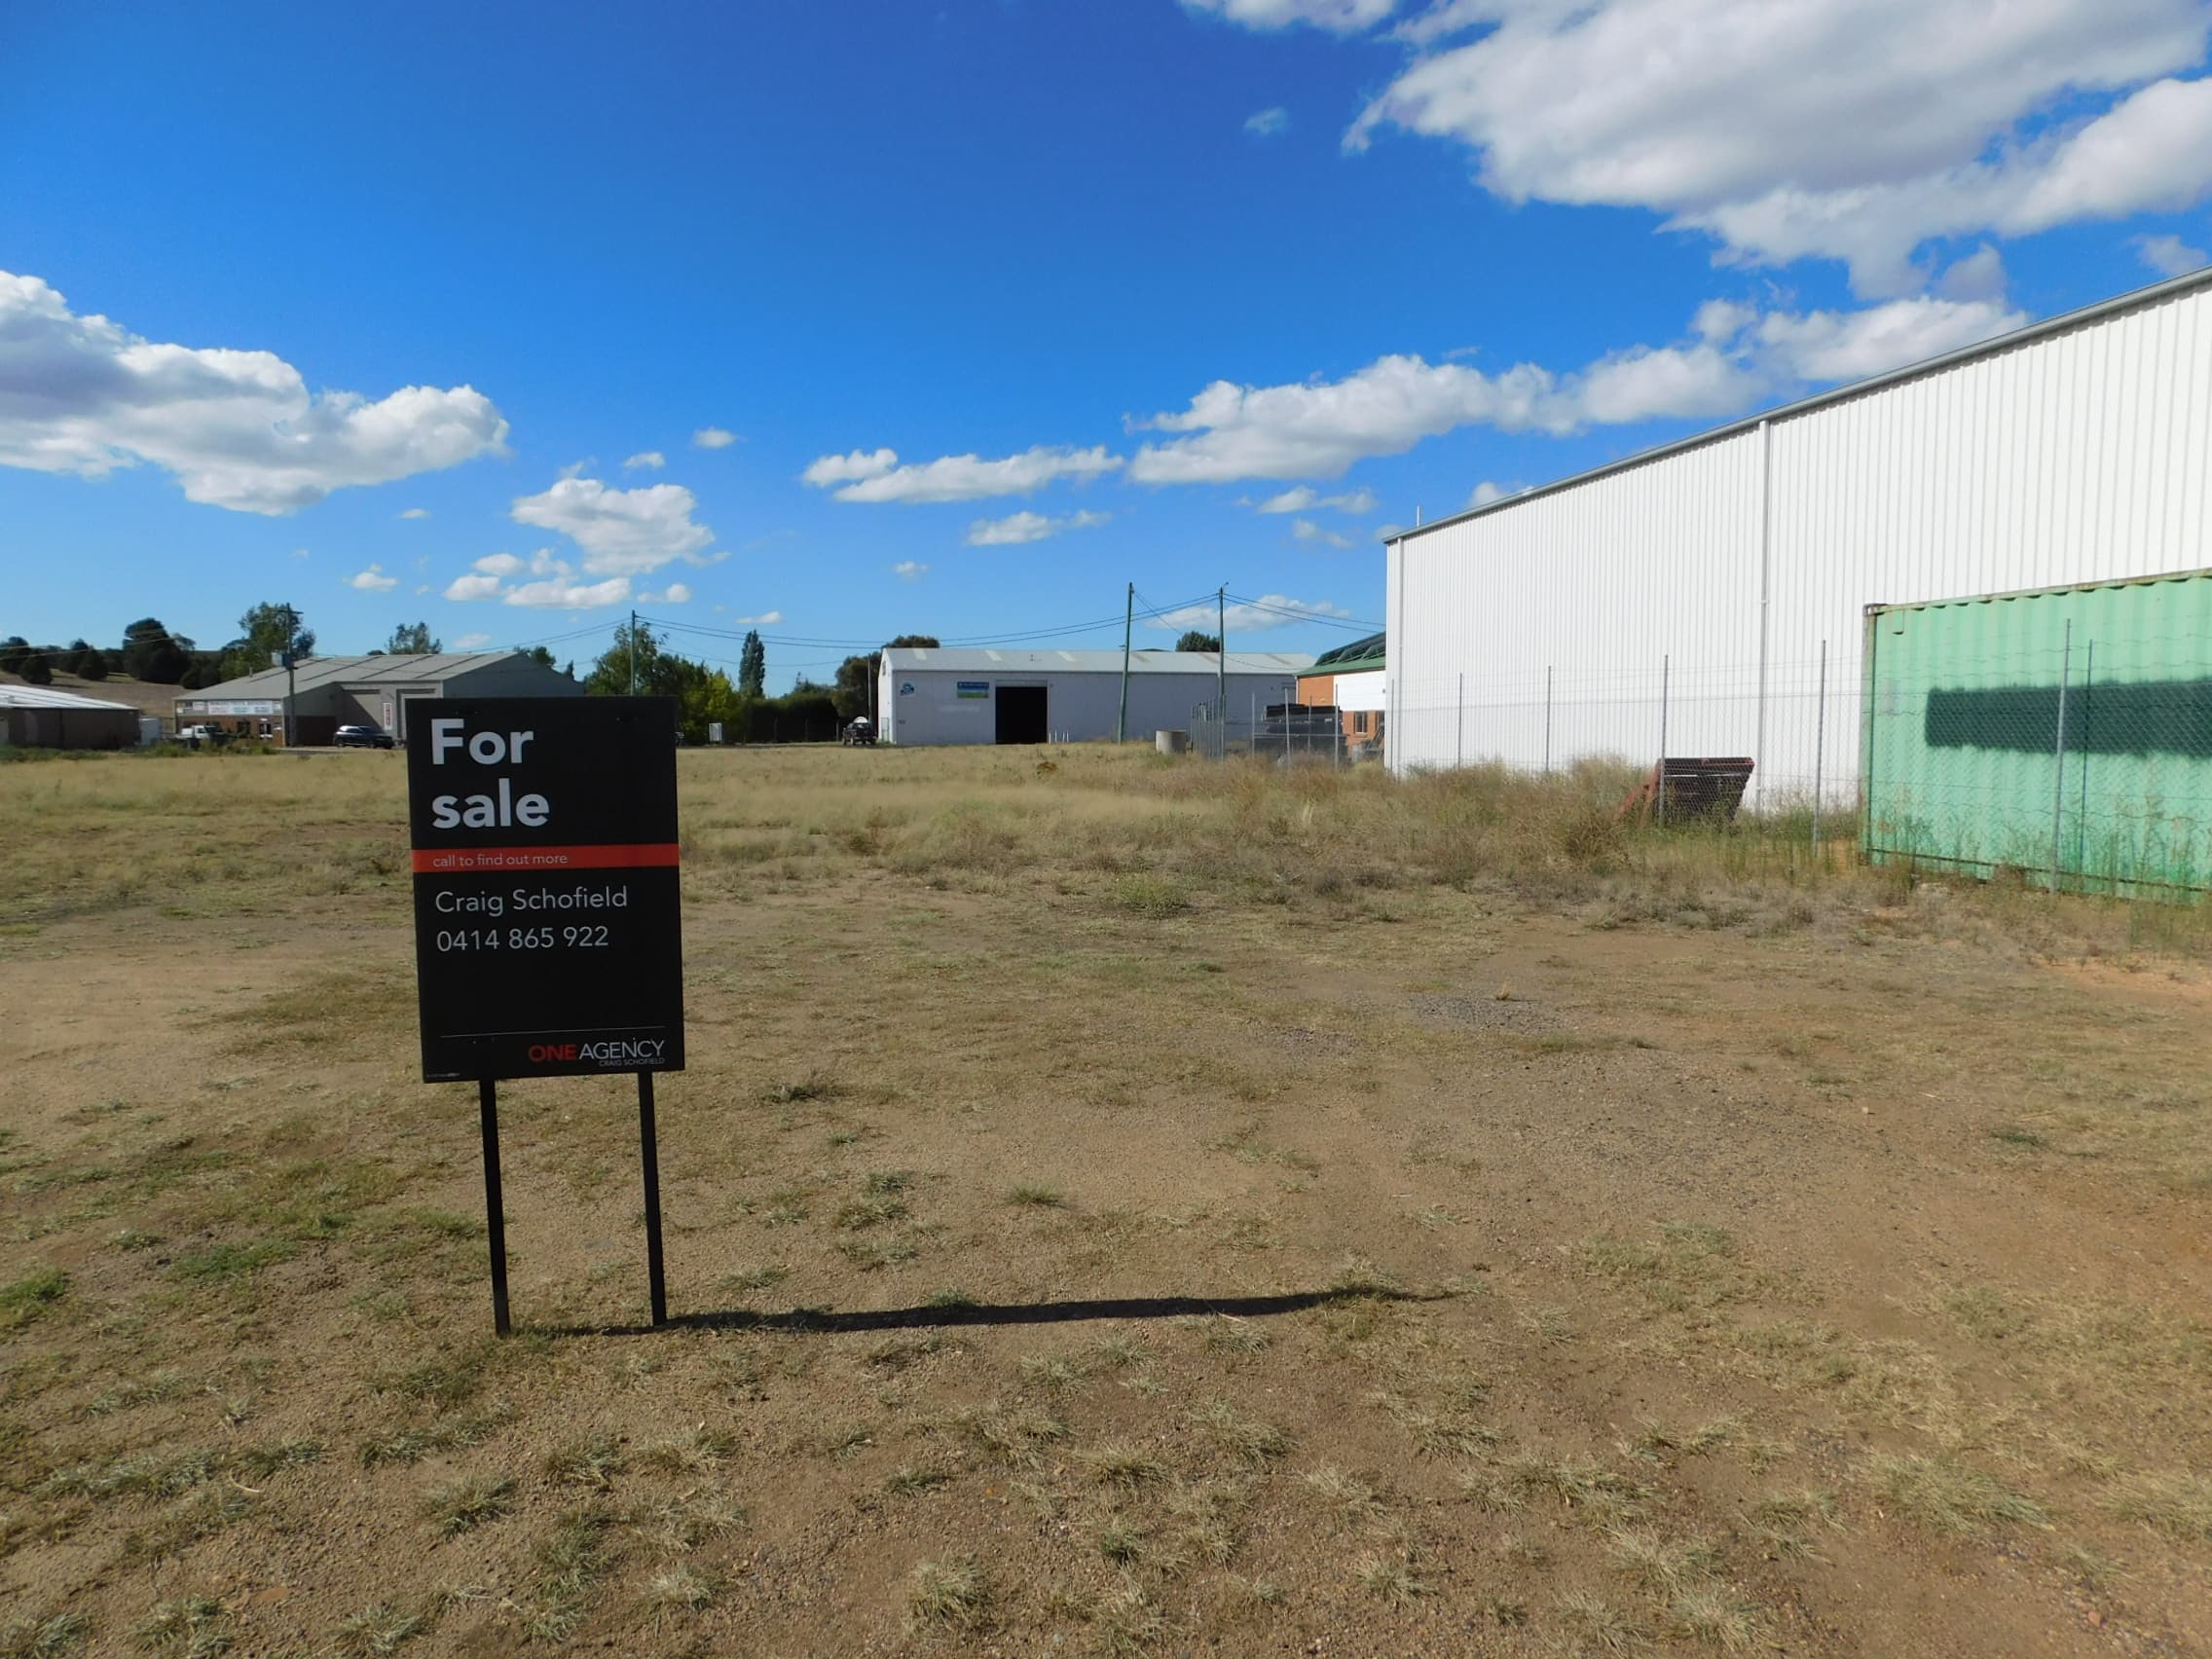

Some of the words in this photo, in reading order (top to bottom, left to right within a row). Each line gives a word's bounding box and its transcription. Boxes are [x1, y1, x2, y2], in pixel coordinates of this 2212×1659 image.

[430, 718, 535, 765] For
[432, 777, 550, 829] sale
[432, 855, 455, 867] call
[460, 856, 474, 867] to
[477, 854, 502, 866] find
[505, 855, 529, 866] out
[533, 855, 568, 866] more
[435, 890, 503, 917] Craig
[512, 885, 628, 910] Schofield
[437, 929, 500, 952] 0414
[508, 927, 554, 949] 865
[563, 926, 608, 947] 922
[529, 1043, 577, 1062] ONE
[578, 1037, 665, 1060] AGENCY
[599, 1058, 623, 1067] CRAIG
